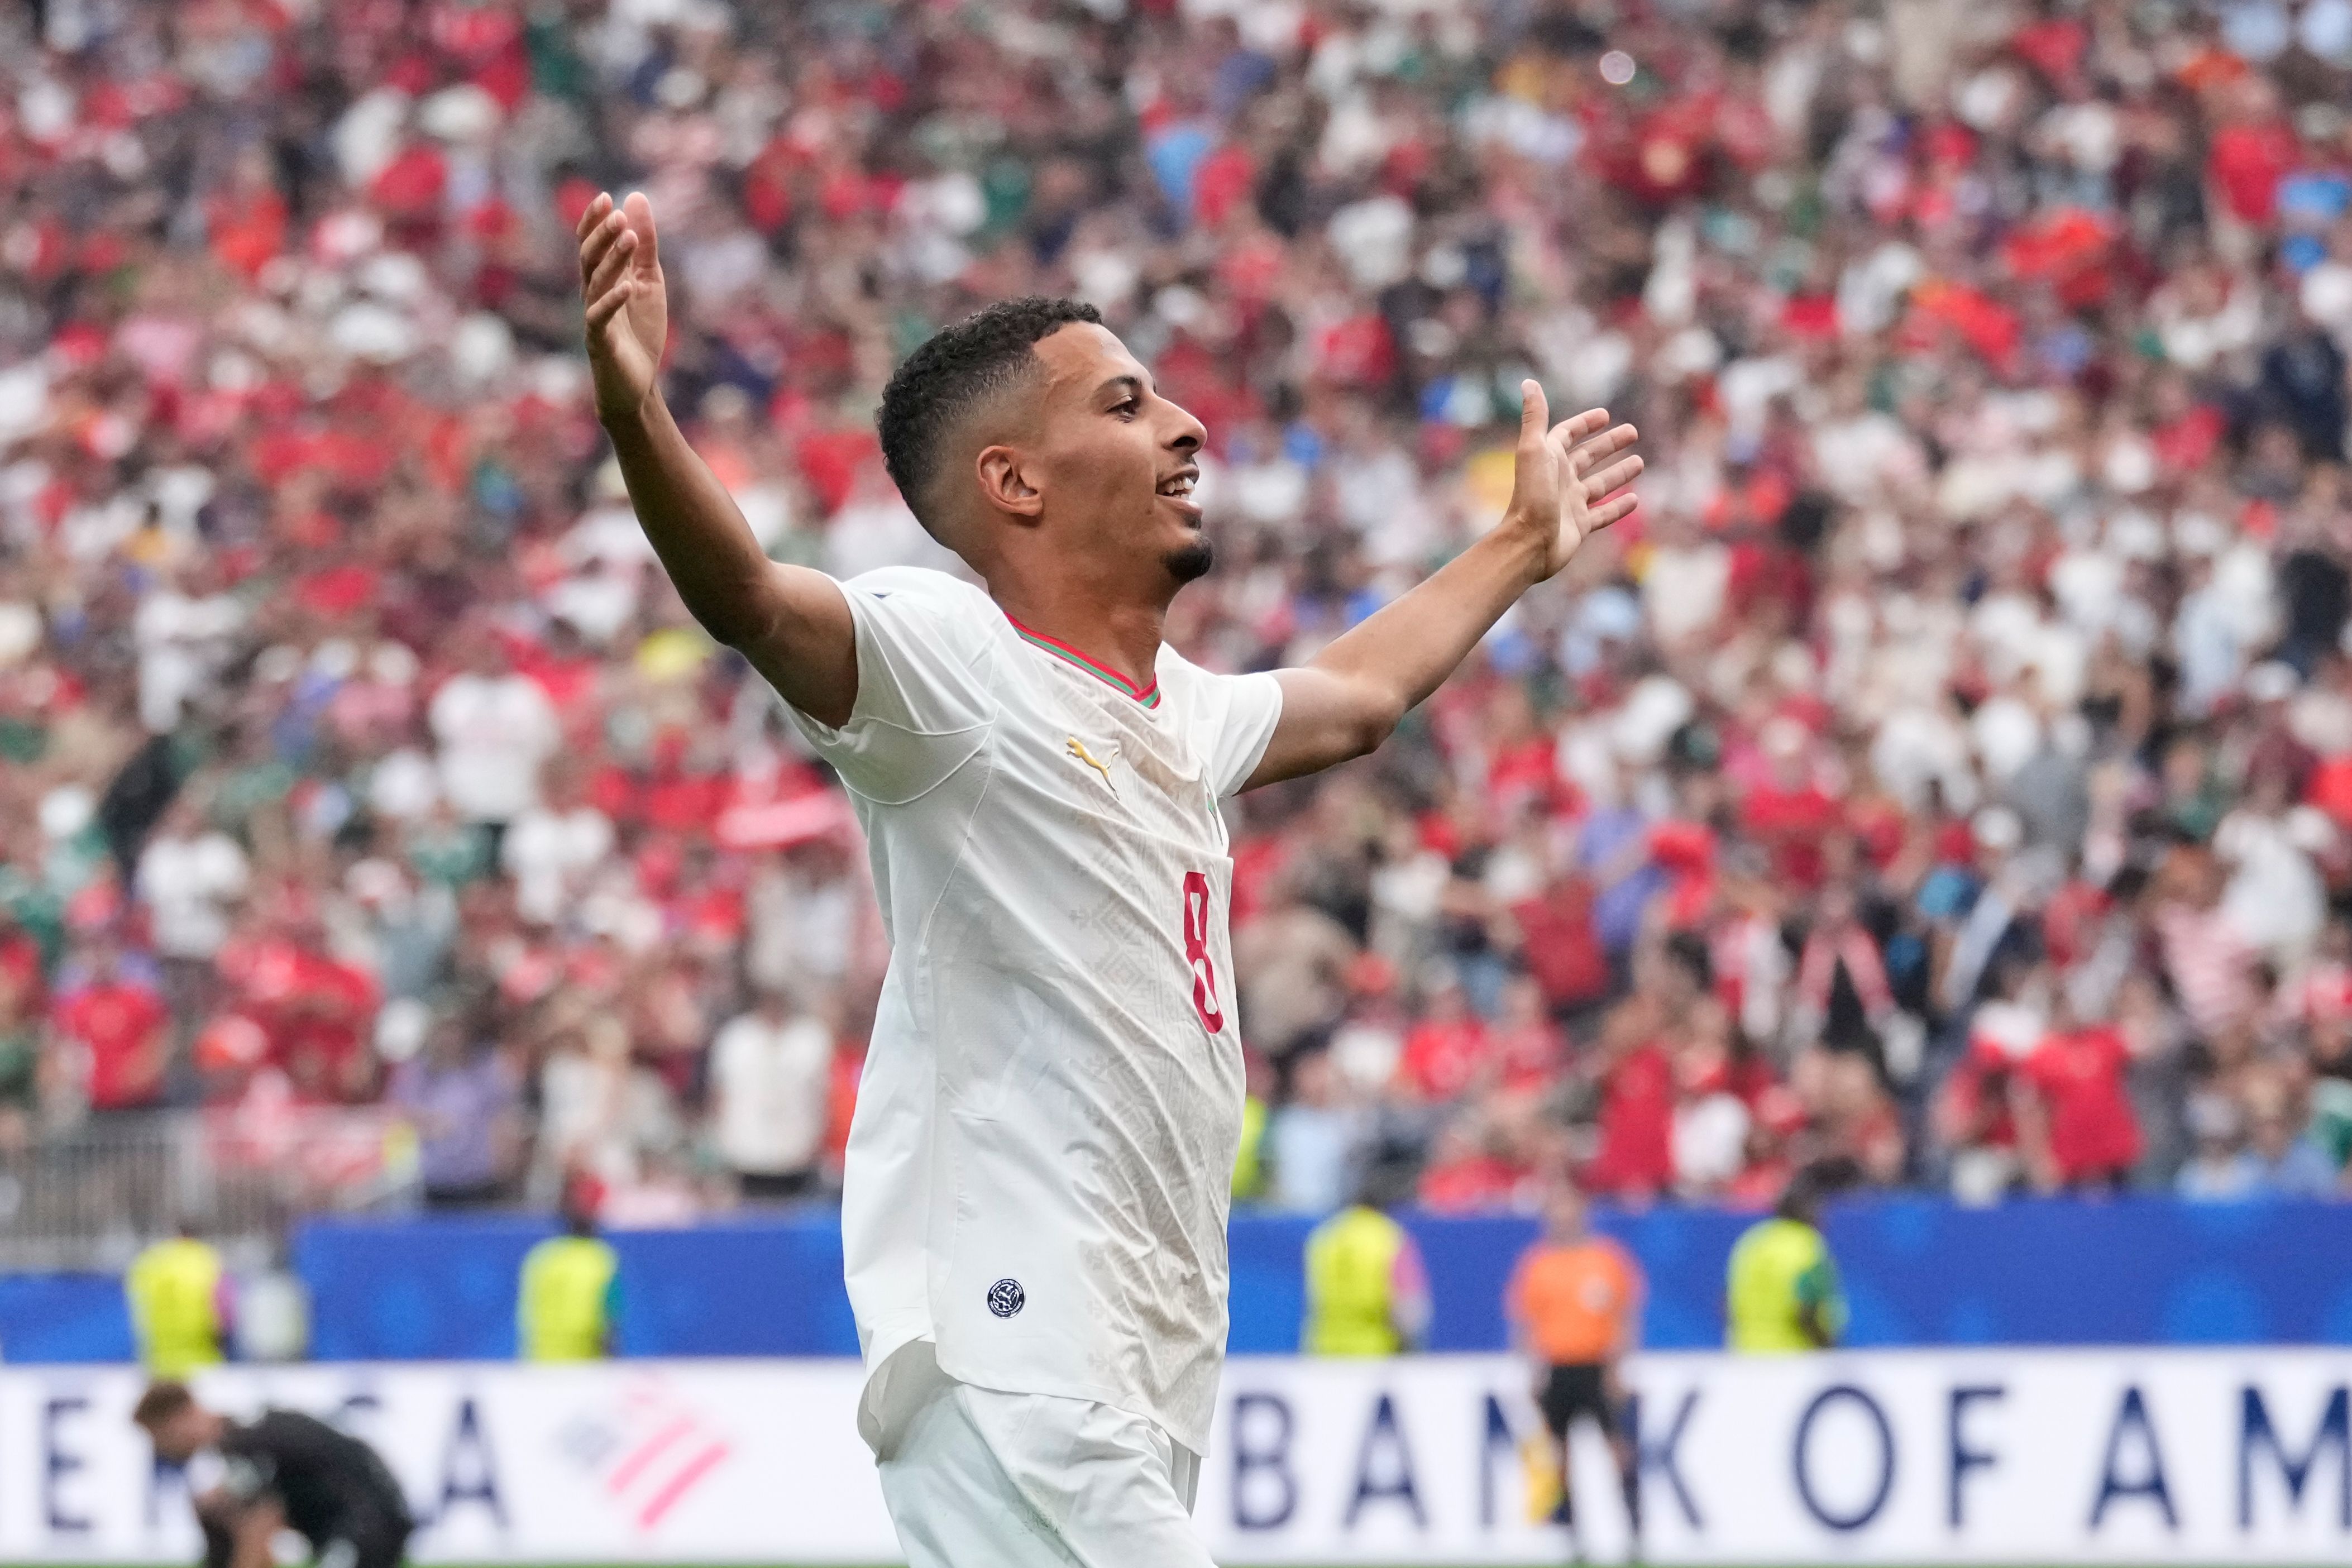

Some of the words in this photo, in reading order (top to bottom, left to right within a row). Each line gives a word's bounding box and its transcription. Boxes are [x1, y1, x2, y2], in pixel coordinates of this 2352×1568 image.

[1183, 871, 1223, 1034] 8
[1794, 1385, 2006, 1531] OF
[2086, 1385, 2352, 1530] AM
